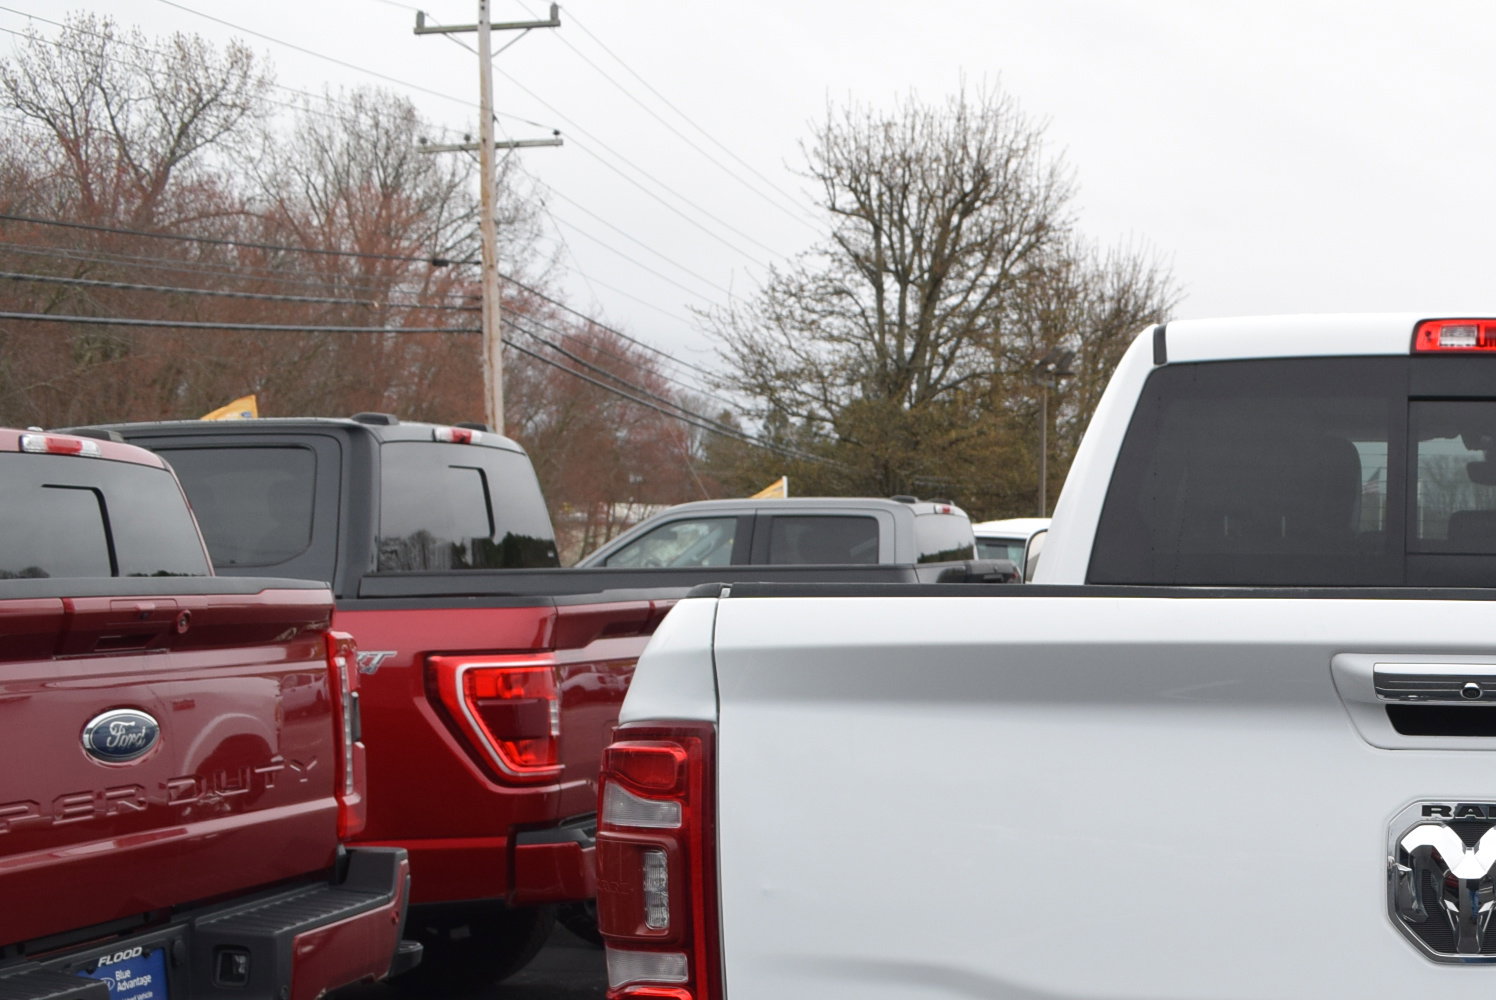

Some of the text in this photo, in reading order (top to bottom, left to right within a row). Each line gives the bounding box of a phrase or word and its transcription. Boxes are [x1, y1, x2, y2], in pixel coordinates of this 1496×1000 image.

[106, 721, 146, 749] Ford
[0, 756, 318, 834] PER DUTY
[98, 947, 142, 967] FLOOD
[115, 969, 131, 981] Blue
[117, 974, 152, 992] Advantage
